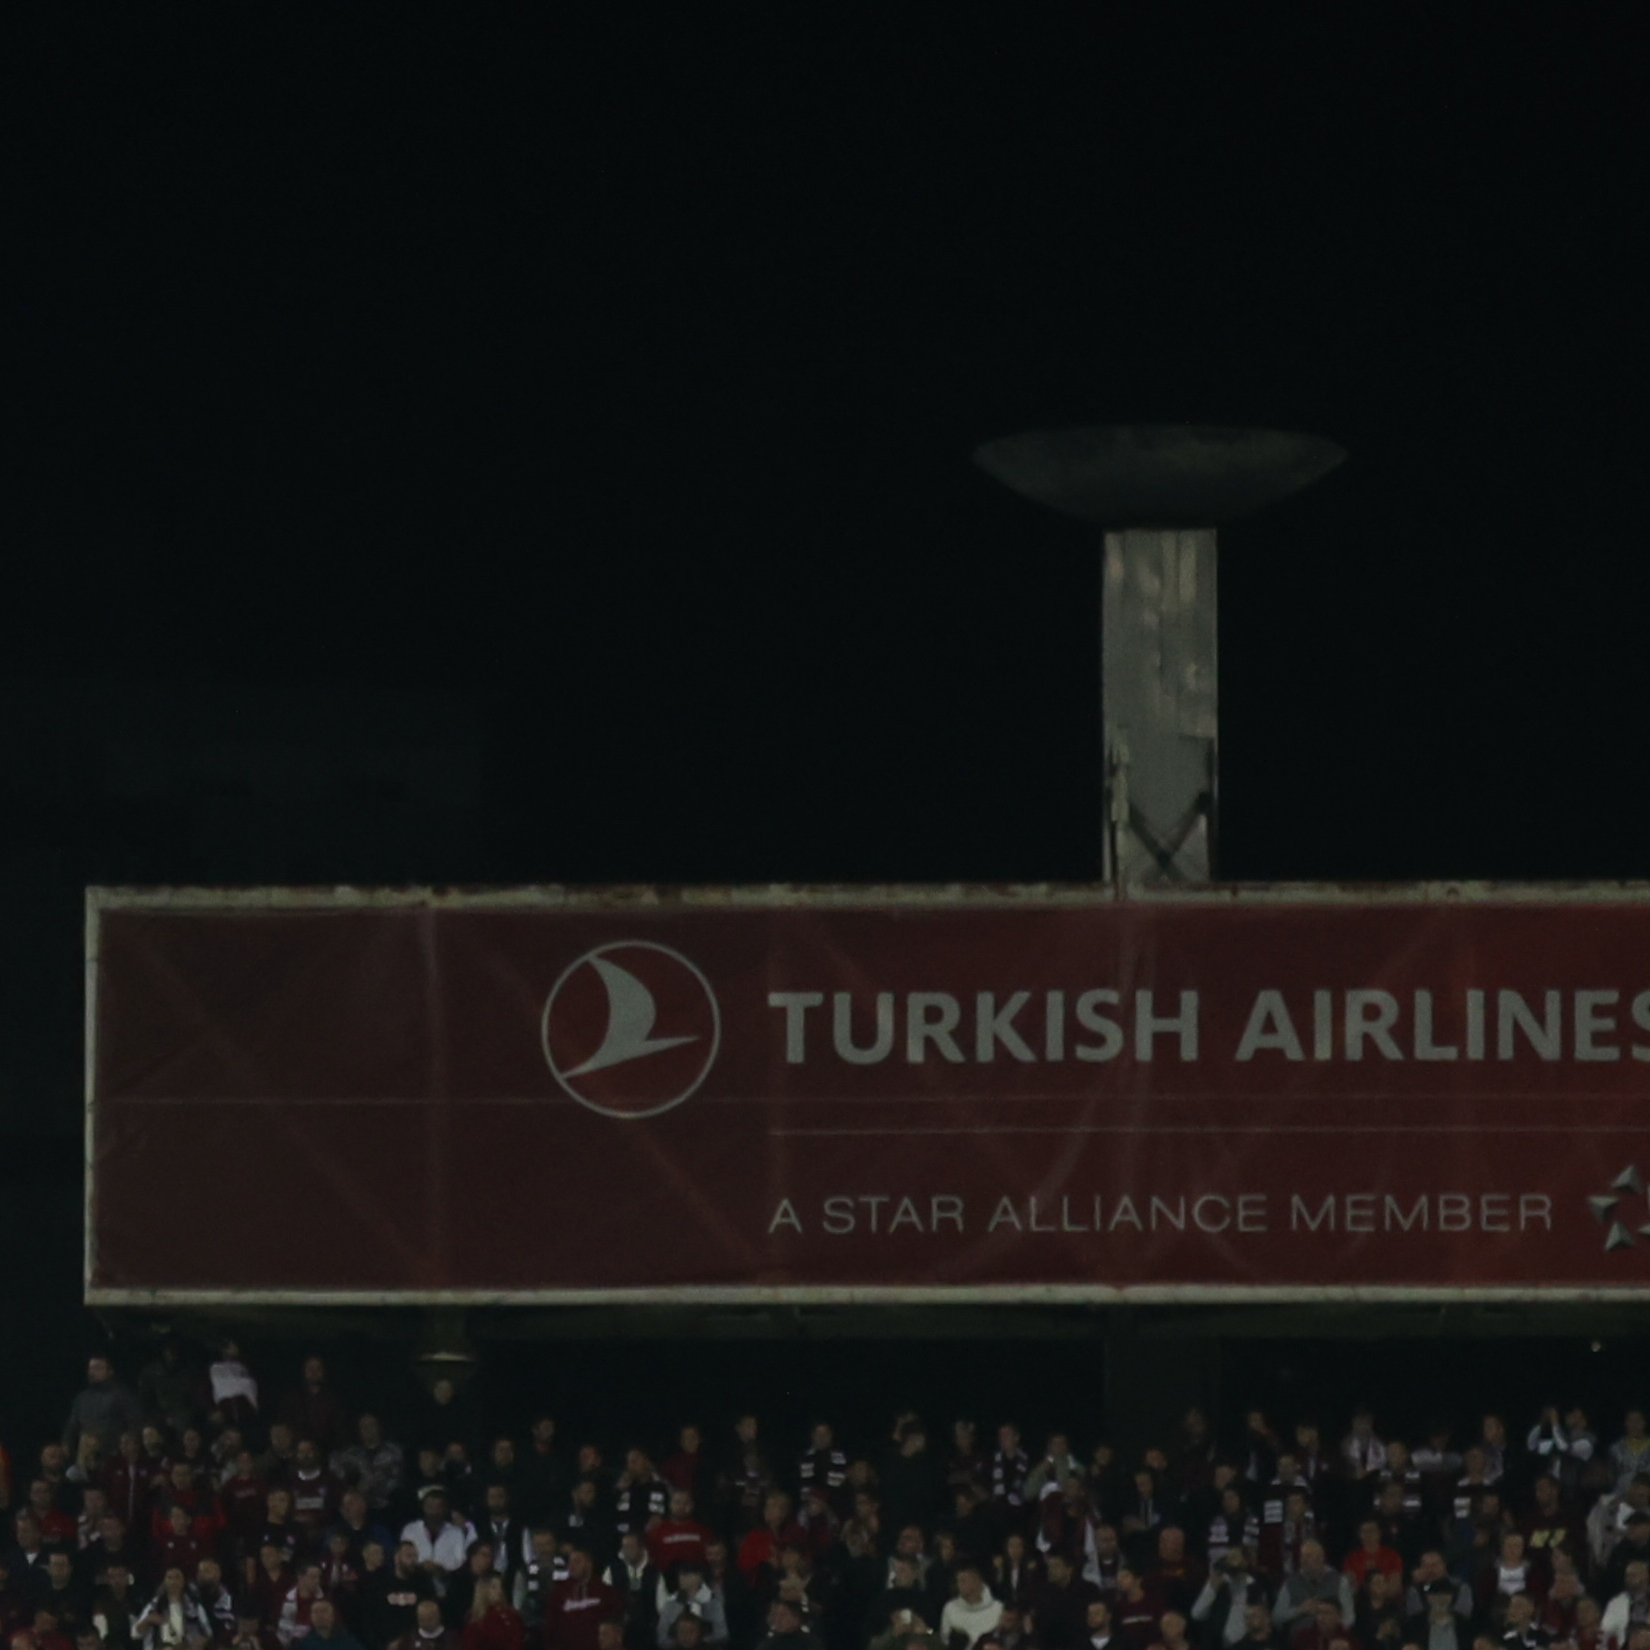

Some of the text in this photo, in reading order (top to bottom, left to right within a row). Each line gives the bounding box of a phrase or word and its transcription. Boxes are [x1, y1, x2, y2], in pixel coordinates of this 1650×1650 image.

[767, 988, 1199, 1065] TURKISH
[768, 1192, 1552, 1234] A STAR ALLIANCE MEMBER
